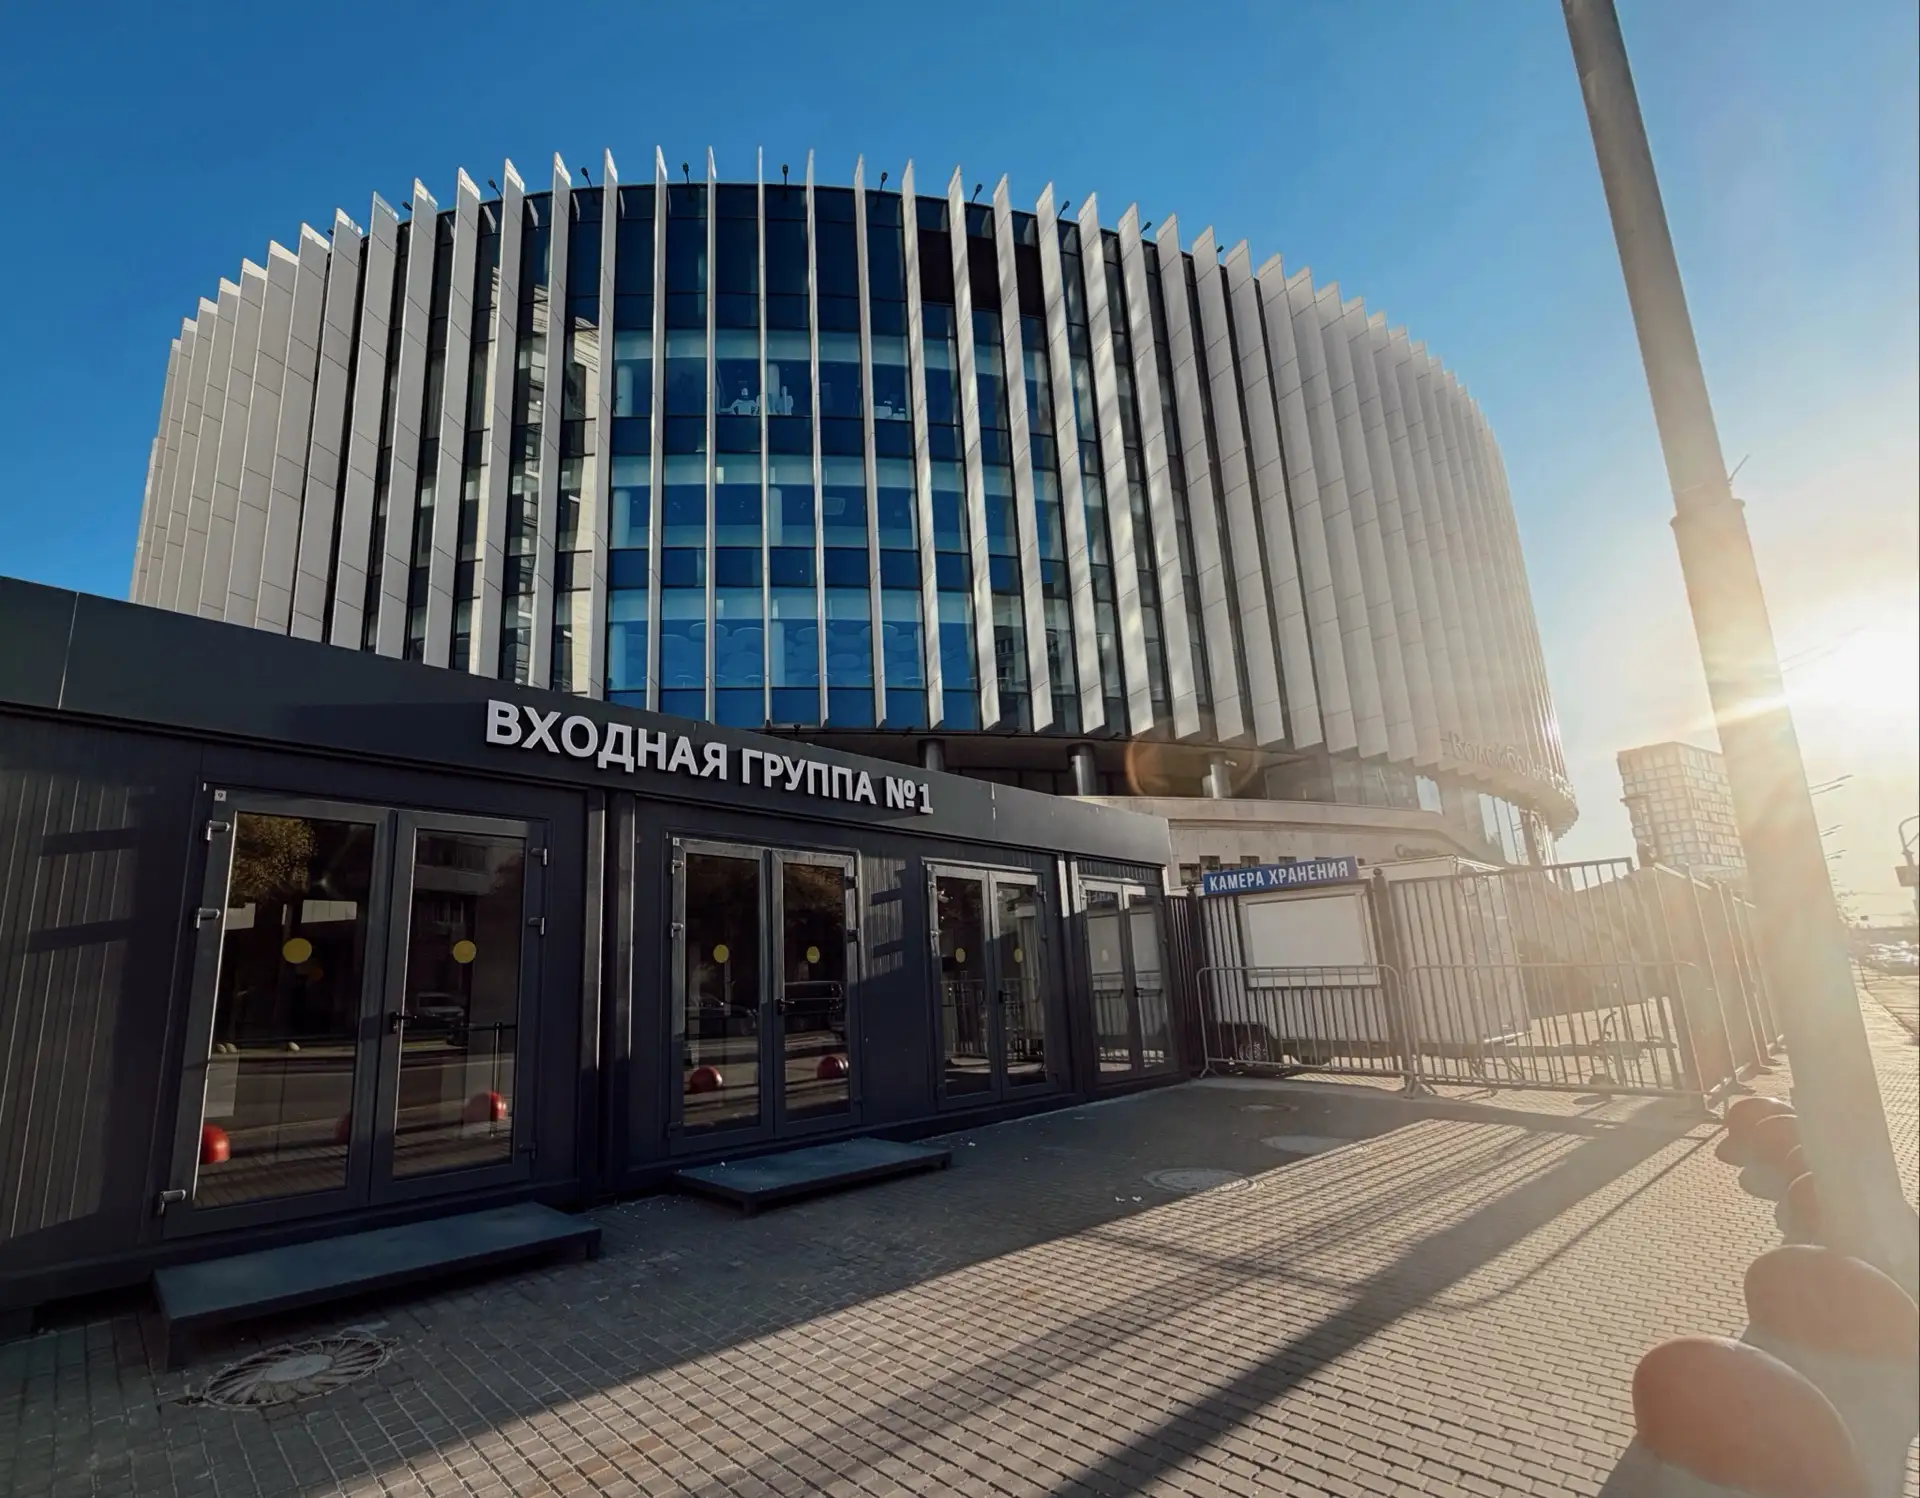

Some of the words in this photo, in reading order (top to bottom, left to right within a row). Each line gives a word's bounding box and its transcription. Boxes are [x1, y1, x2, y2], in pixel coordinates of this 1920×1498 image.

[486, 699, 728, 781] ВХОДНАЯ
[741, 748, 877, 805] ГРУППА
[885, 776, 934, 814] №1
[1209, 871, 1265, 892] КАМЕРА
[1268, 860, 1349, 886] ХРАНЕНИЯ
